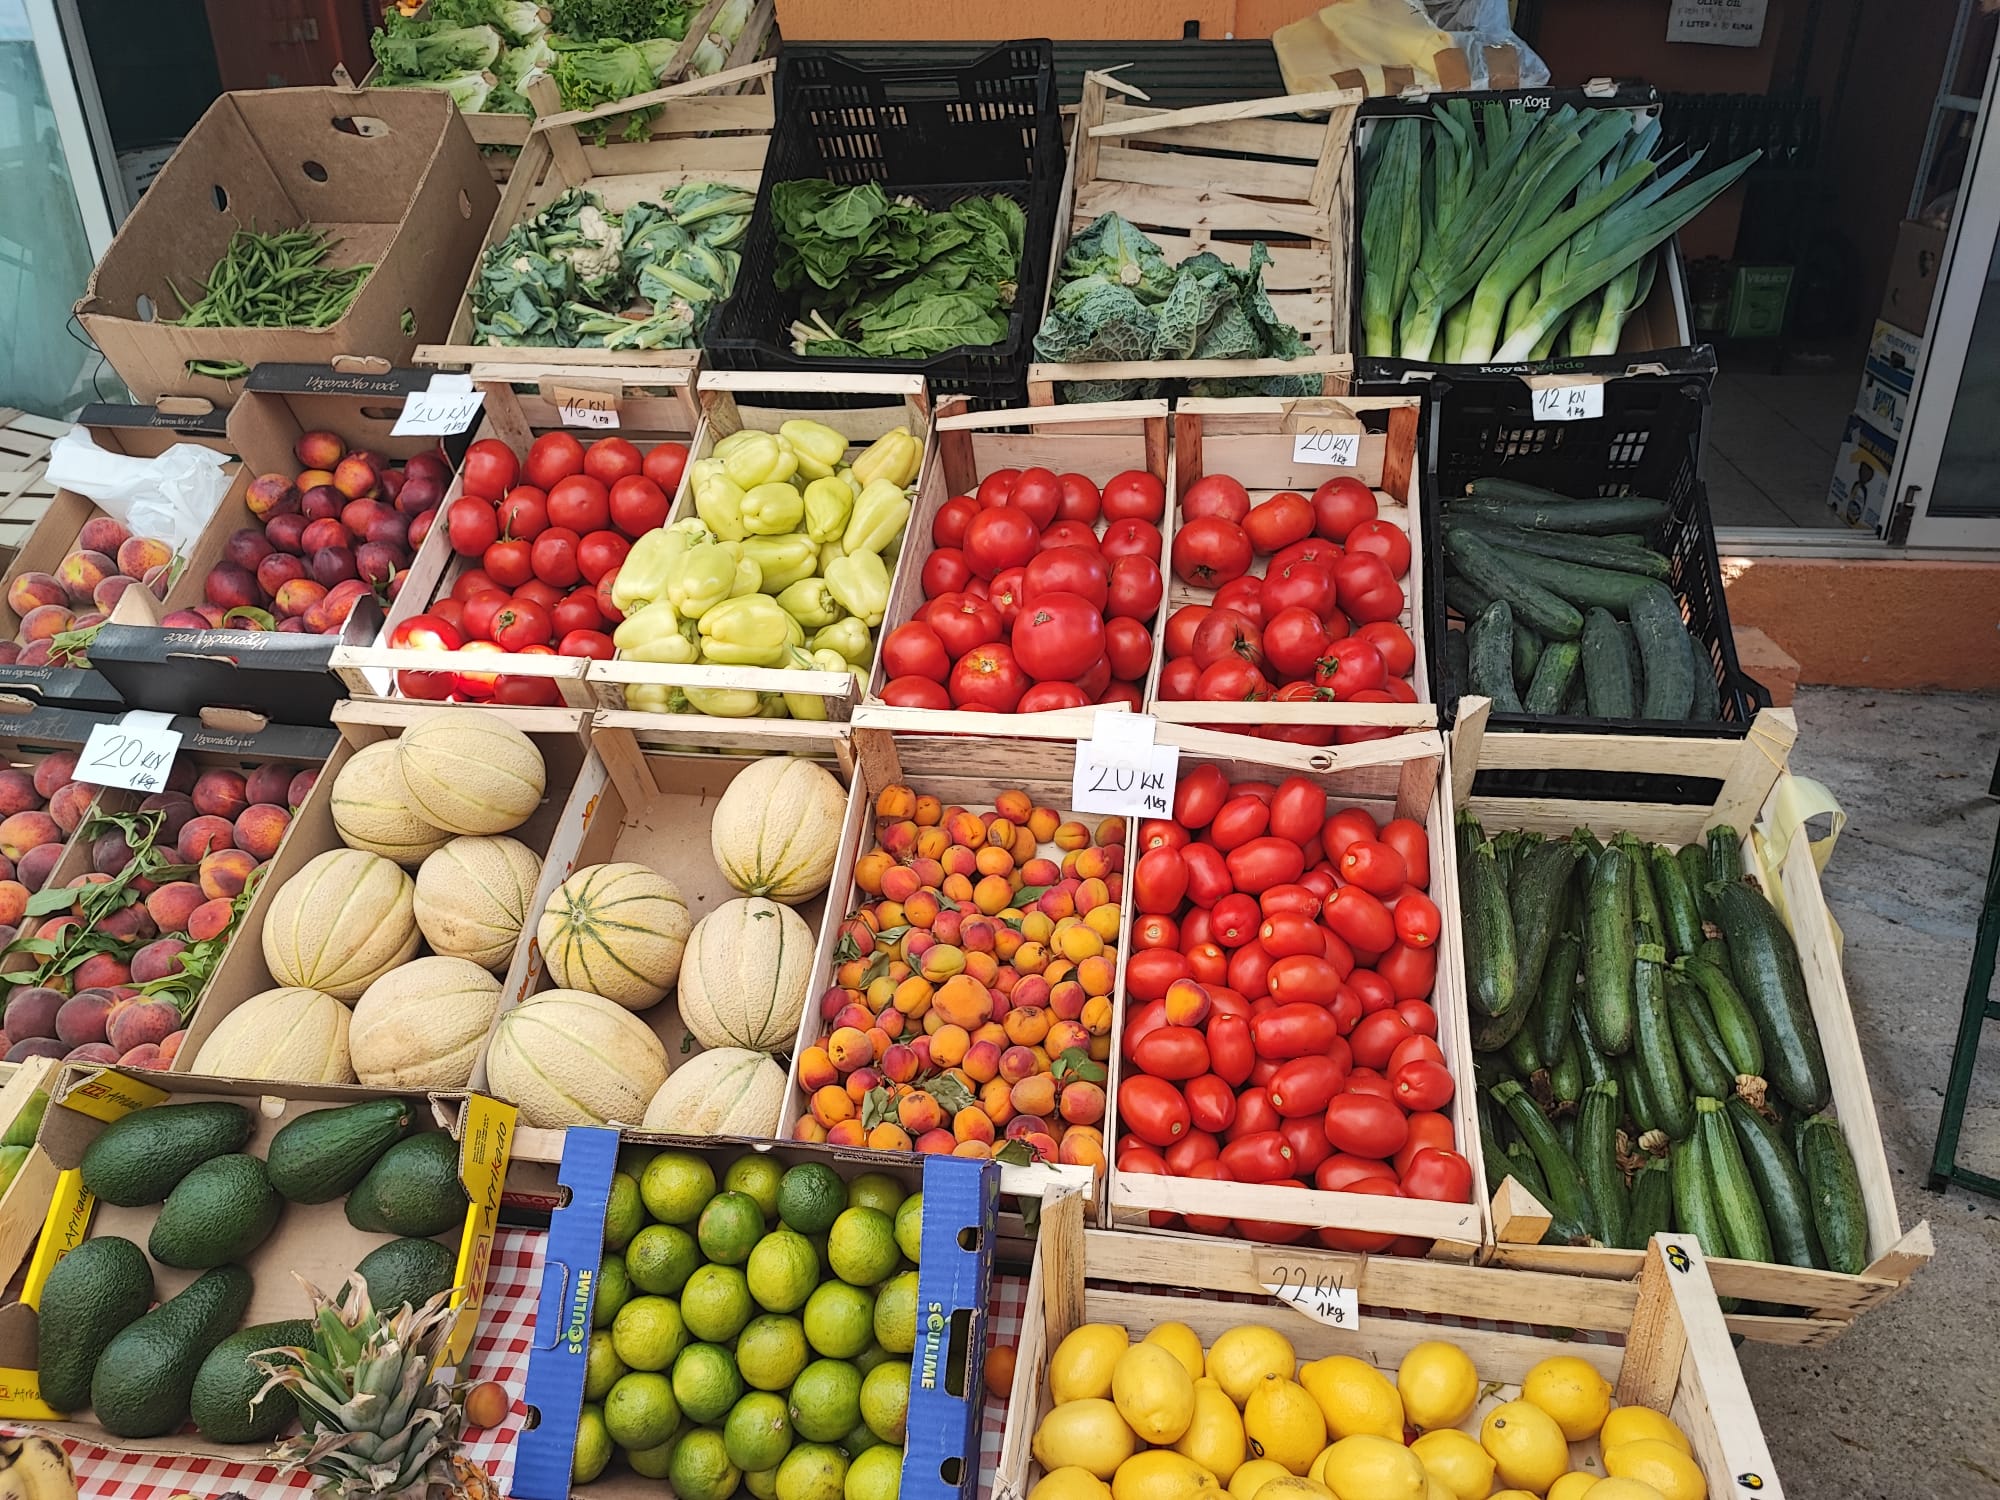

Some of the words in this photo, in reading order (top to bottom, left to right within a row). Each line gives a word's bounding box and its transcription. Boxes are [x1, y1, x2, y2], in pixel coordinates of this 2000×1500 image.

[1725, 0, 1742, 8] OIL
[1479, 365, 1530, 375] Royal
[565, 396, 586, 418] 16
[589, 399, 606, 412] KN
[1539, 388, 1561, 412] 12
[1567, 389, 1586, 406] KN
[1300, 426, 1334, 452] 20
[1333, 436, 1354, 454] KN
[90, 734, 143, 768] 20
[140, 752, 170, 771] KN
[484, 1120, 508, 1230] Afrikado
[66, 1183, 90, 1248] Afrikado
[469, 1241, 488, 1303] ZZ2
[1272, 1266, 1309, 1304] 22
[1314, 1274, 1344, 1299] KN
